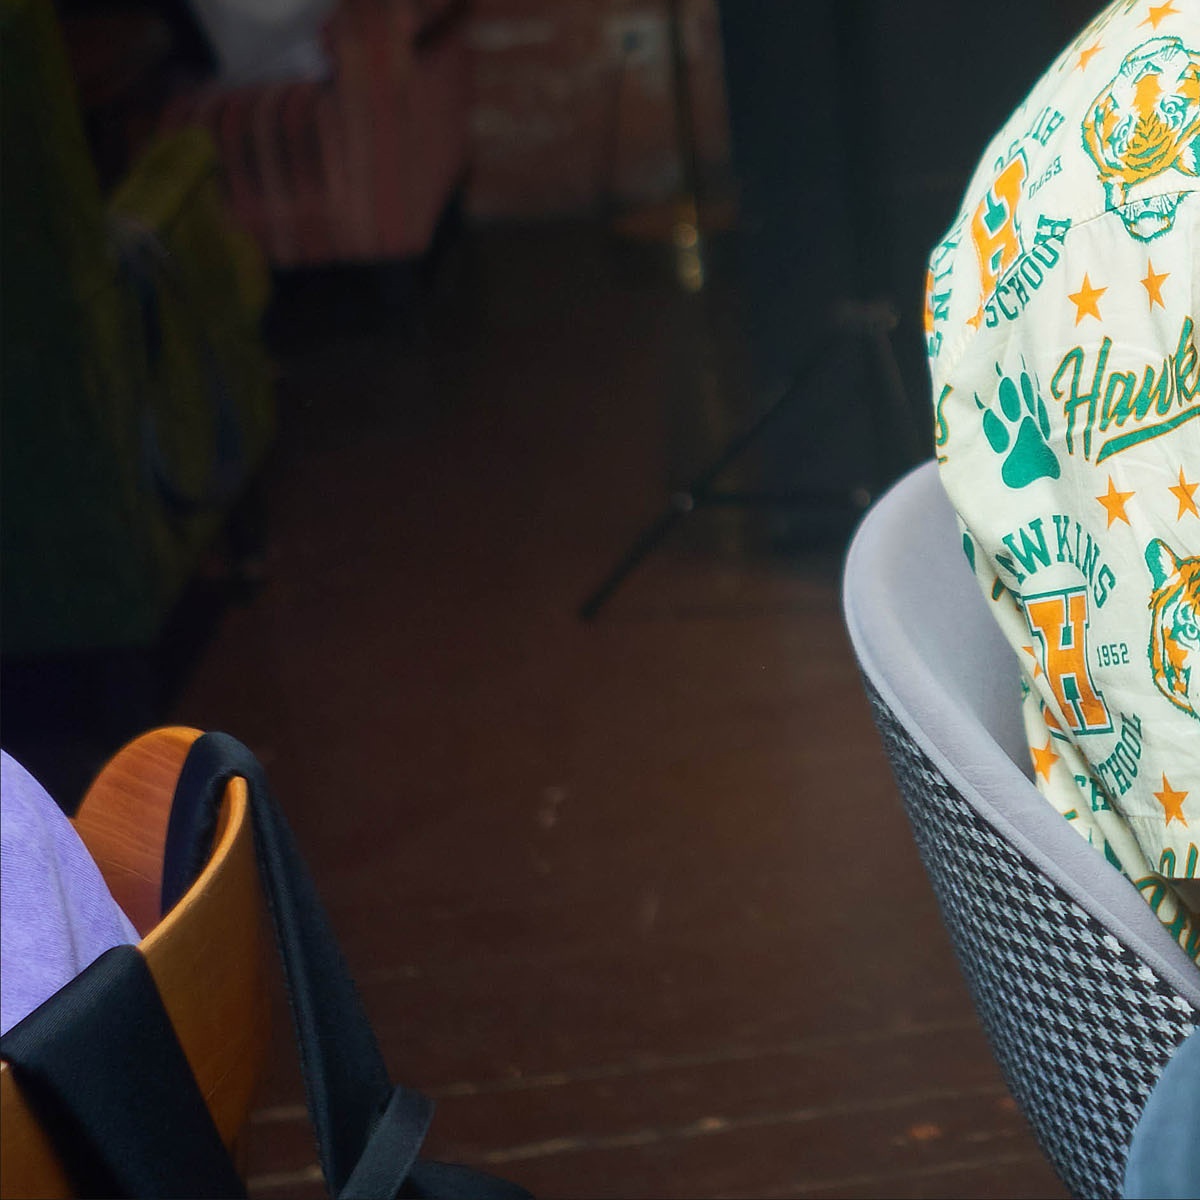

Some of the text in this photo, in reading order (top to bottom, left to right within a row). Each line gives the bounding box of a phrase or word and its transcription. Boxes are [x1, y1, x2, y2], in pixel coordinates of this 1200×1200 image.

[1021, 585, 1115, 736] H
[1096, 643, 1130, 668] 1952
[1091, 711, 1143, 799] CHOOL
